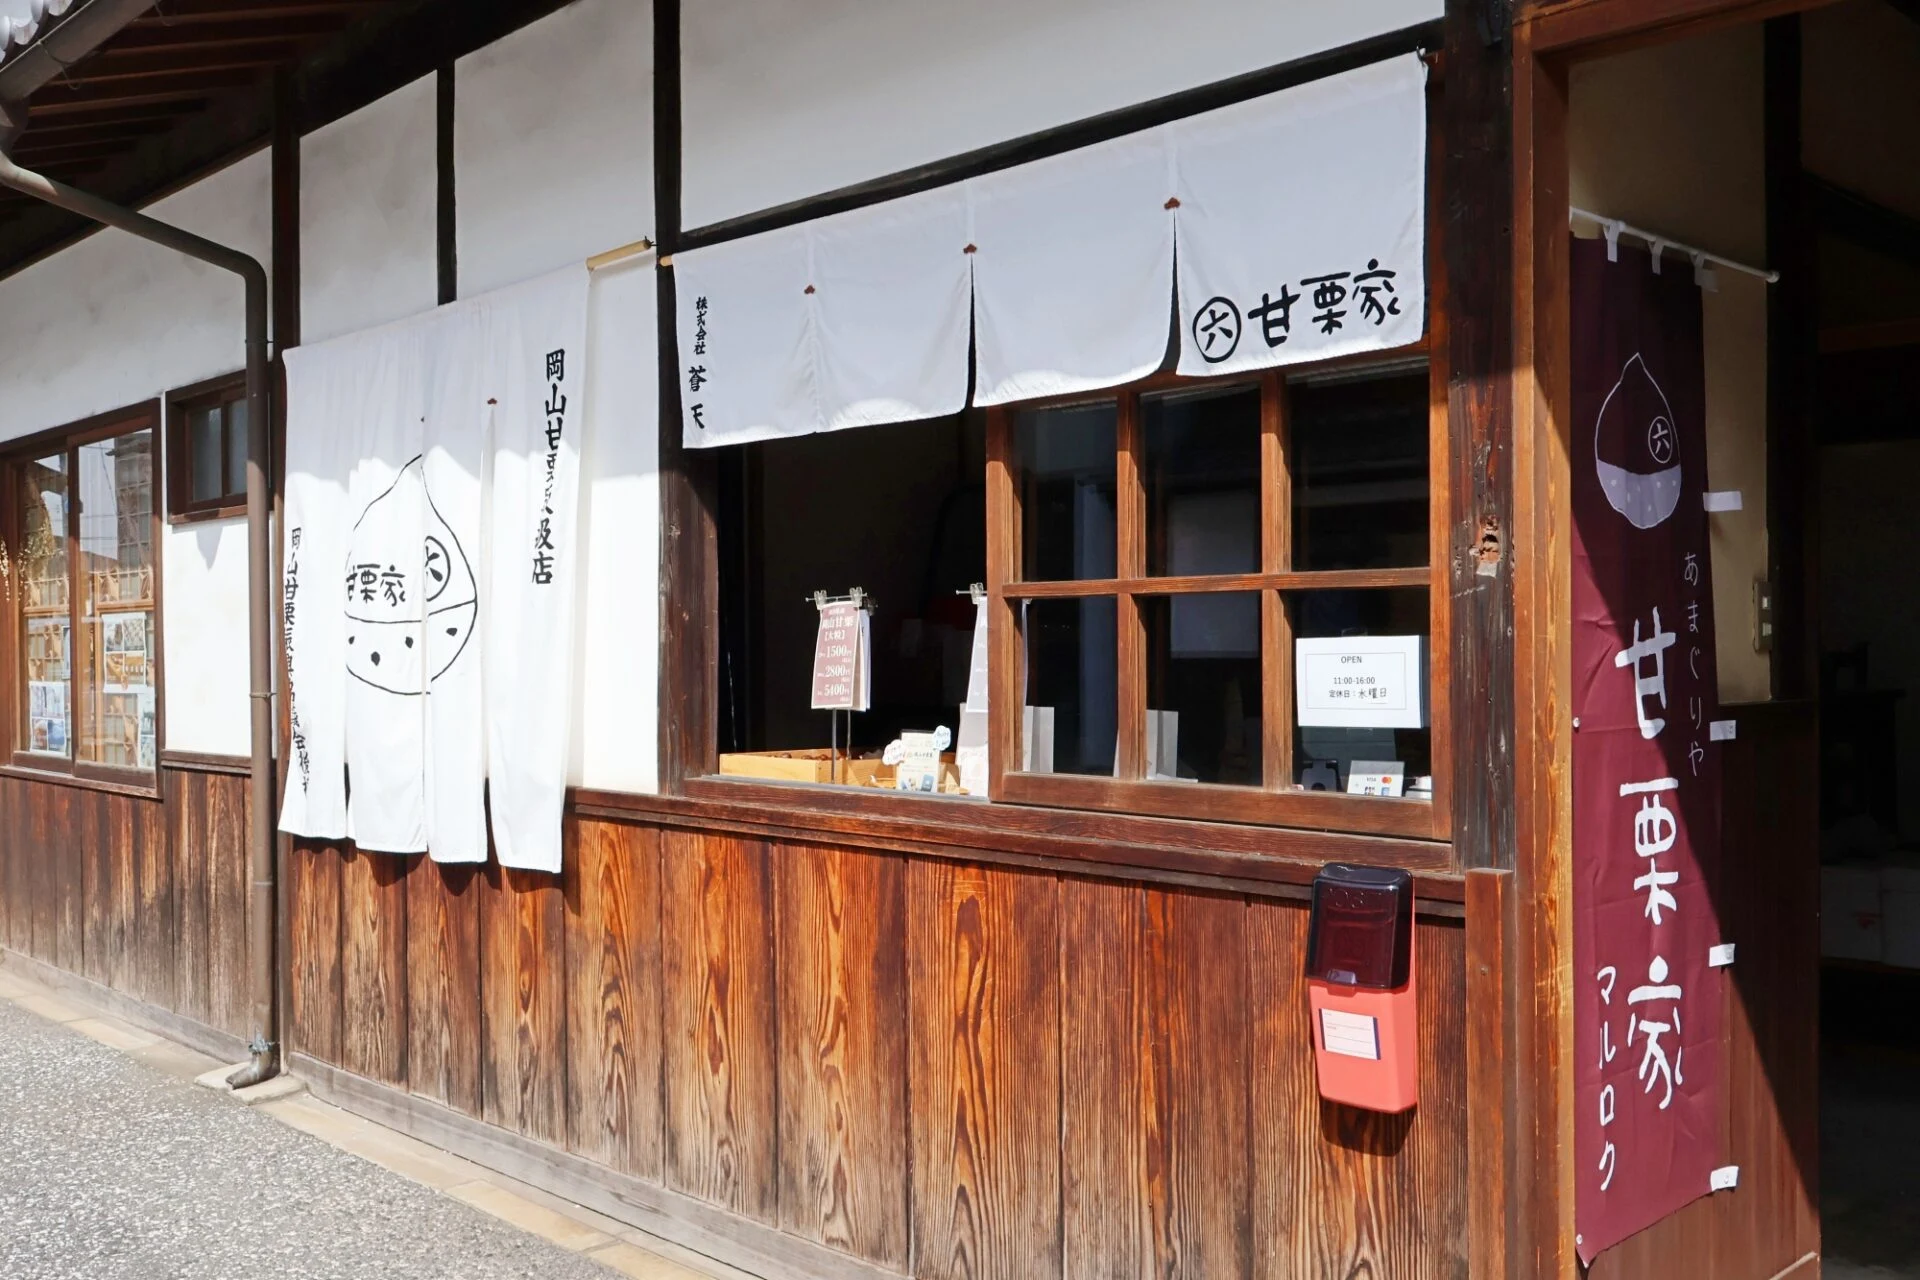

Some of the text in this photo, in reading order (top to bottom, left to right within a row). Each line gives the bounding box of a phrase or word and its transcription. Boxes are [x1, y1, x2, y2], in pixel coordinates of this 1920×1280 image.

[693, 296, 708, 355] 株式会社
[1248, 258, 1401, 348] 甘栗家
[1333, 677, 1375, 685] 11:00-16:00
[1341, 656, 1362, 664] OPEN
[1684, 552, 1703, 776] あまぐりや
[1615, 606, 1681, 1109] 甘栗家
[1597, 966, 1616, 1191] マルロク
